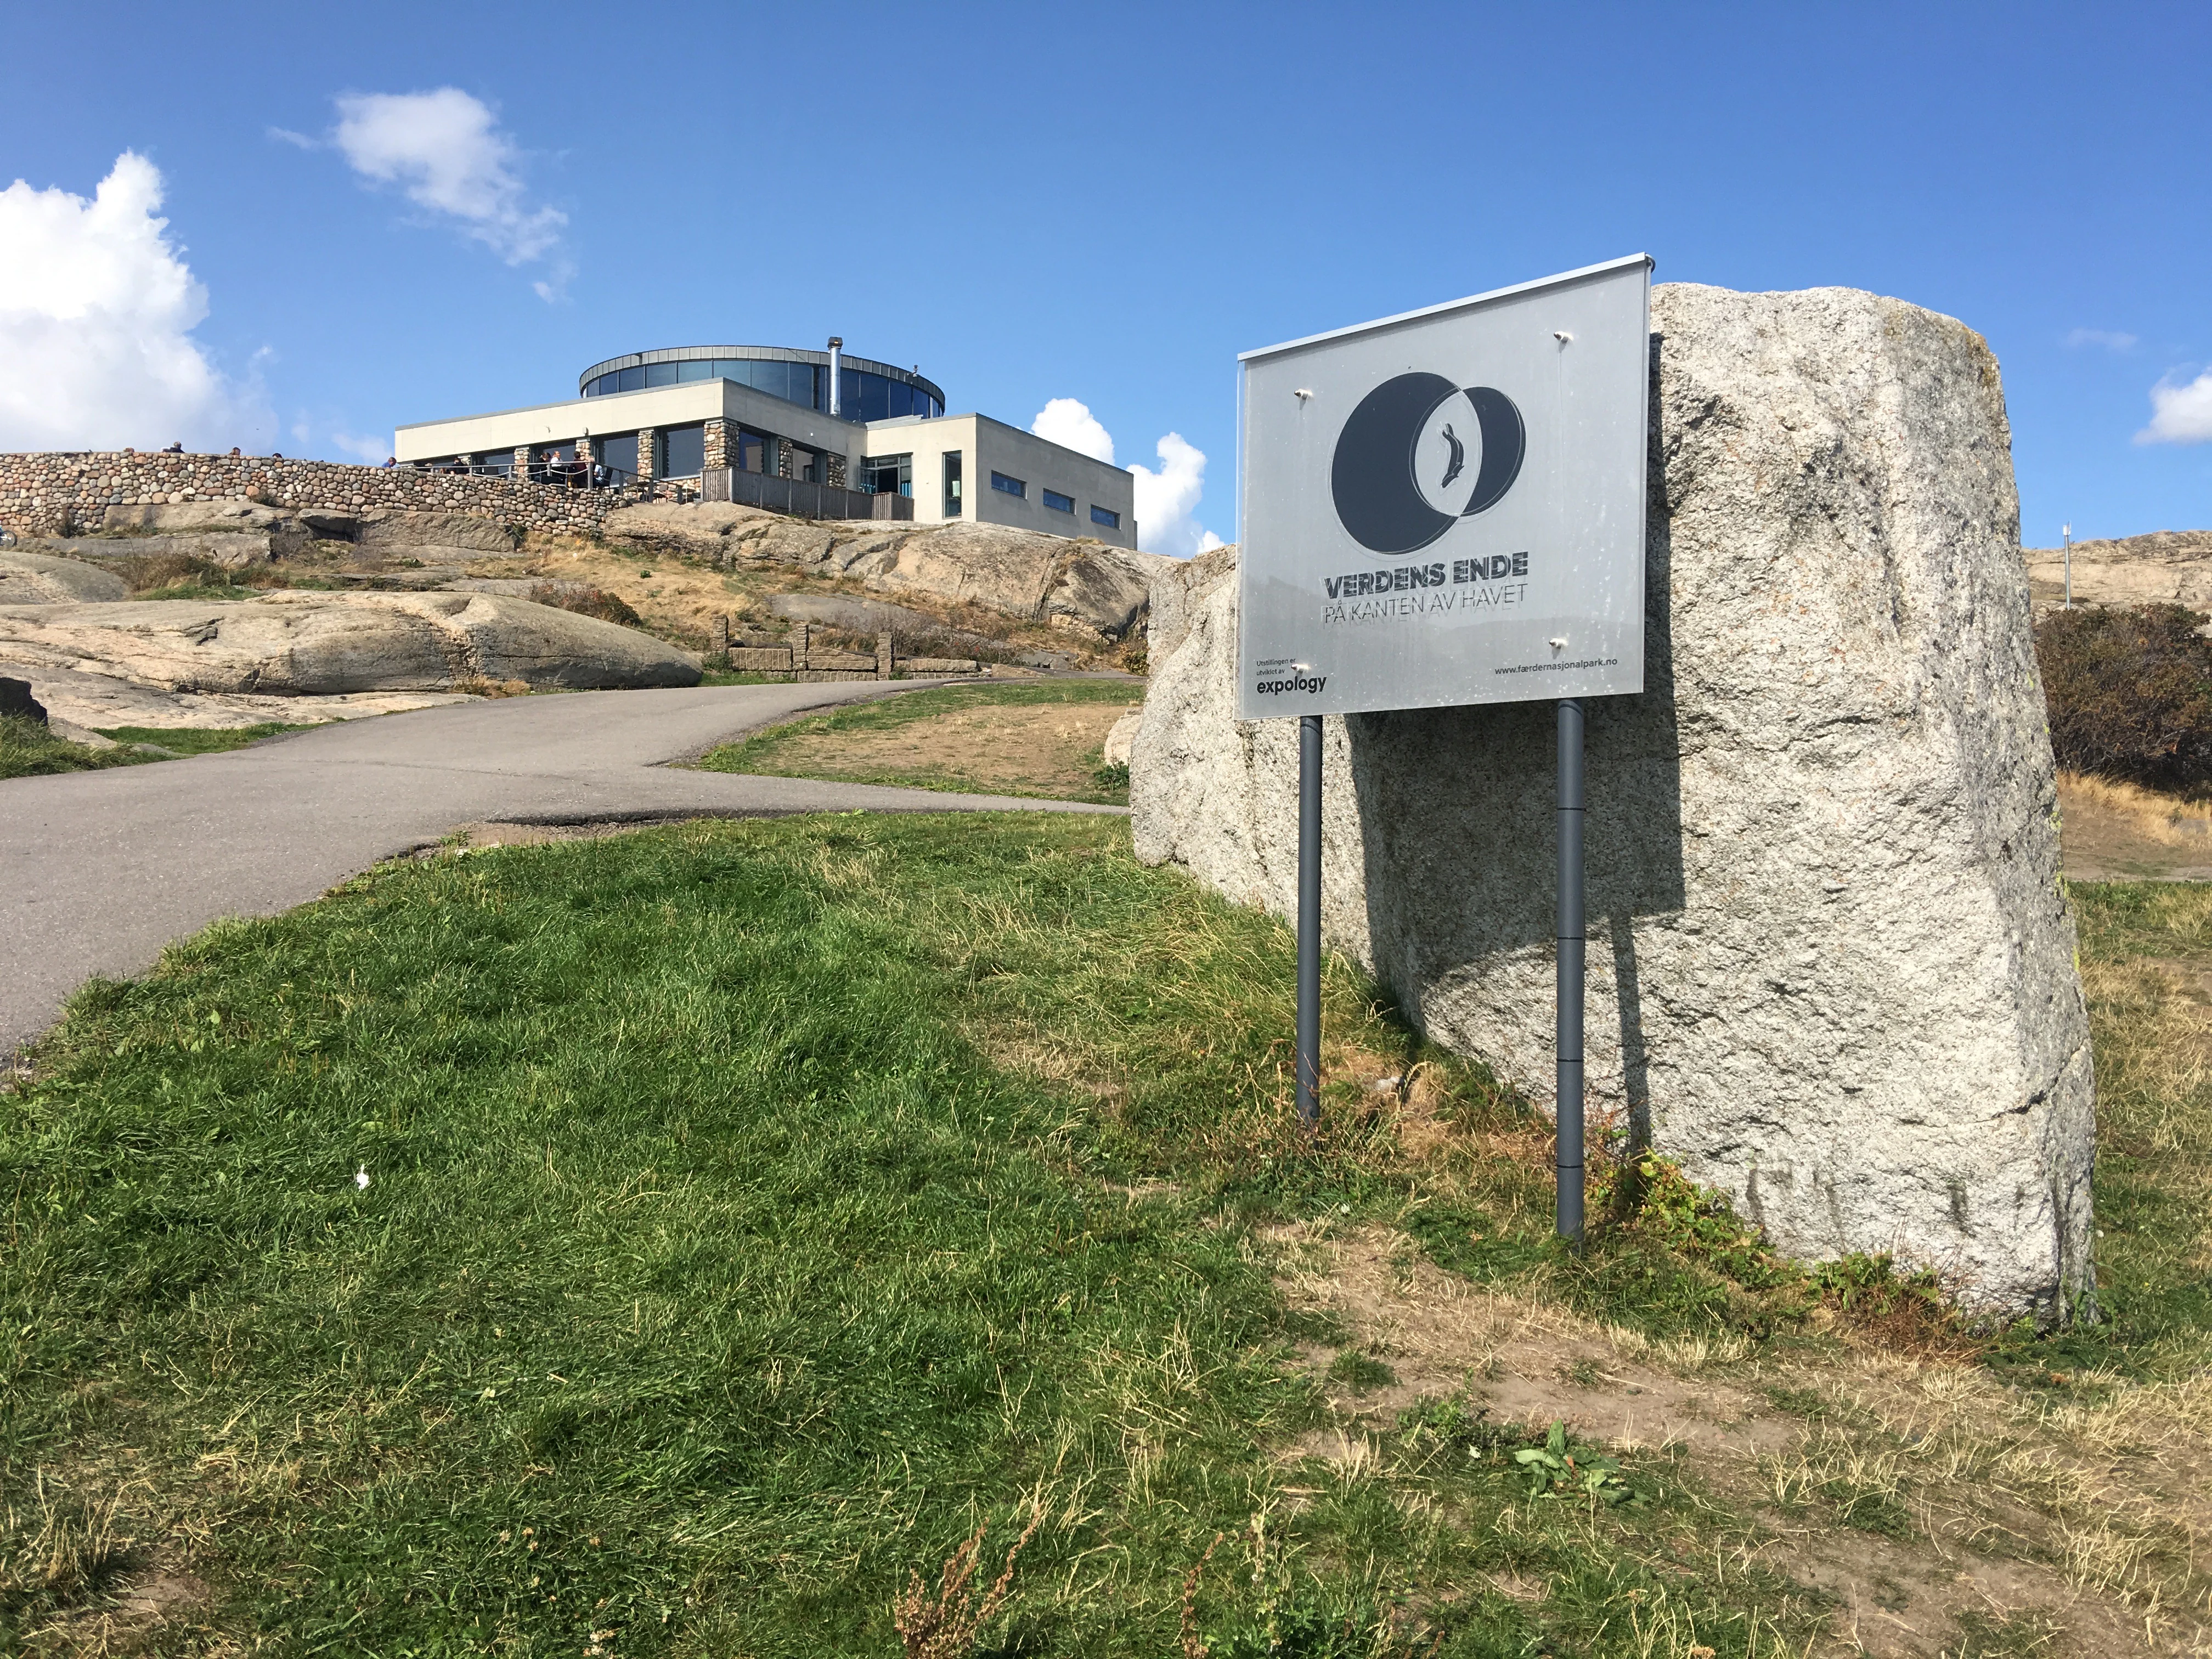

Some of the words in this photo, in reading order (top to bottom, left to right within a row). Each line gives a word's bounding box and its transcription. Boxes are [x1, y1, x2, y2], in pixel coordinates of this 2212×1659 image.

[1324, 563, 1446, 599] VERDENS
[1453, 551, 1528, 584] ENDE
[1325, 600, 1346, 623] PÅ
[1351, 595, 1424, 620] KANTEN
[1430, 591, 1455, 612] AV
[1462, 583, 1528, 608] HAVET
[1256, 658, 1289, 667] Utstillingen
[1495, 658, 1618, 674] www.færdernasjonalpark.no
[1257, 675, 1327, 696] expology
